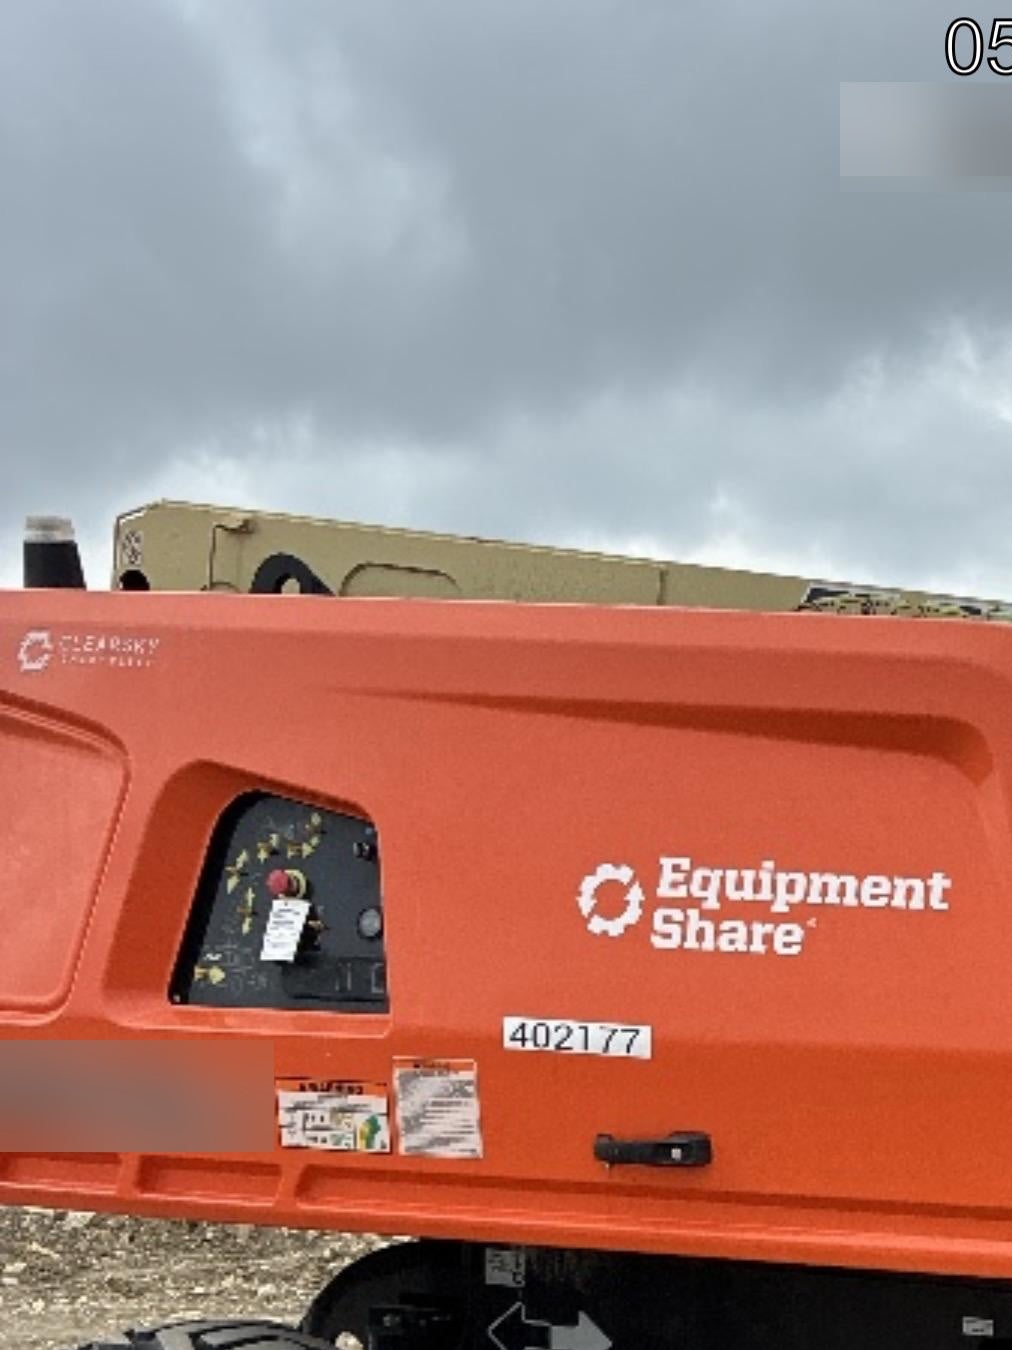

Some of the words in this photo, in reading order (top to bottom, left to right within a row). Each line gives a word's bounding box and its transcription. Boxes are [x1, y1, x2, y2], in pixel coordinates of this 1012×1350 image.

[656, 856, 952, 913] Equipment
[650, 908, 804, 955] Share
[509, 1021, 641, 1055] 402177
